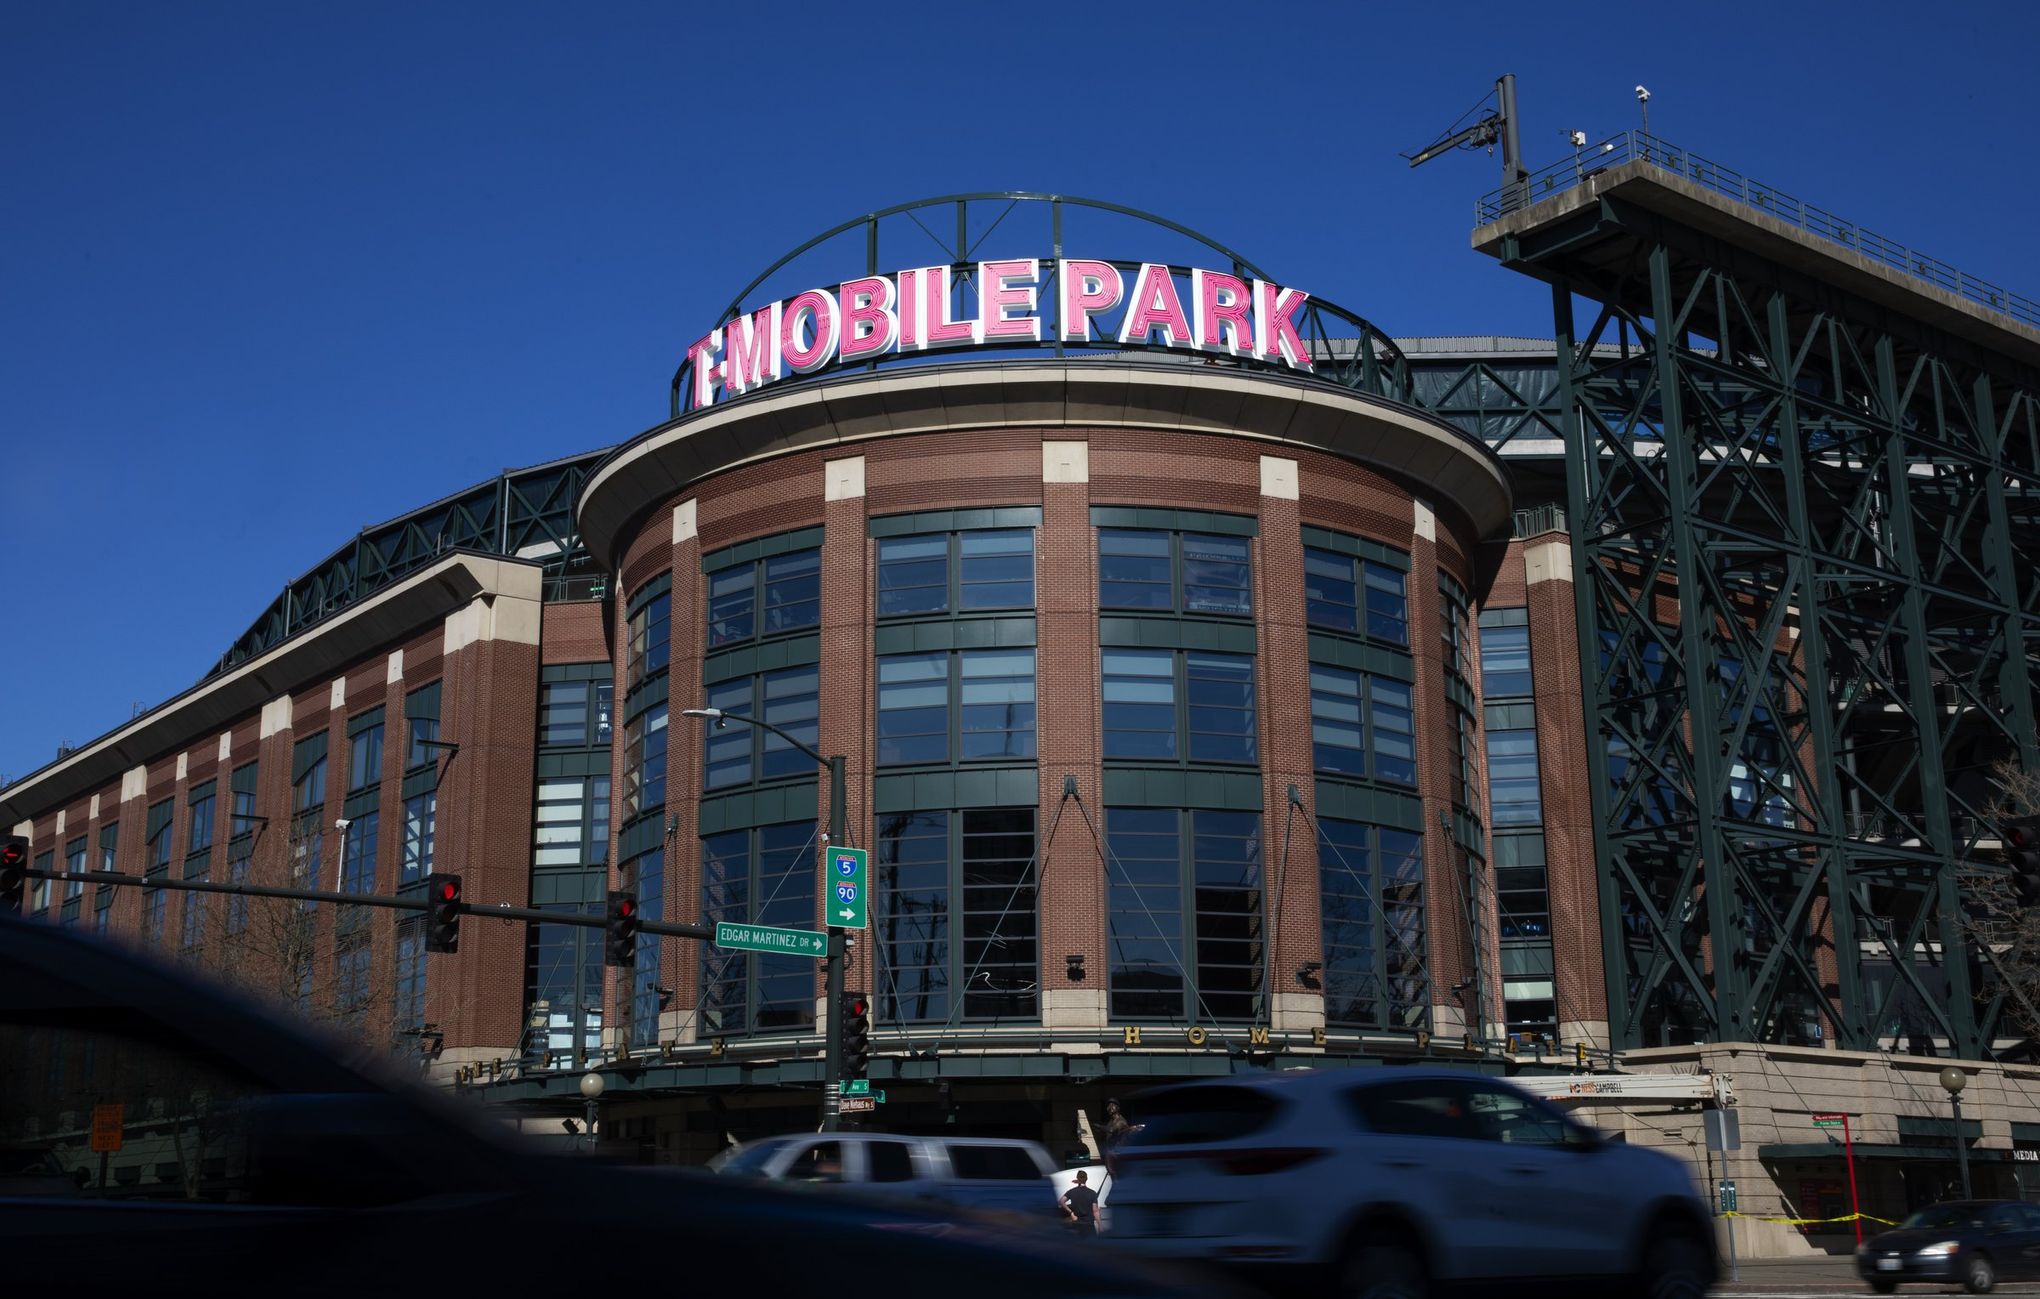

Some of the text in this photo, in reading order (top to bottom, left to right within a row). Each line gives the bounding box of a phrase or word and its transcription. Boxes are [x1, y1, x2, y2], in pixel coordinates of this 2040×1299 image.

[688, 257, 1314, 407] T-MOBILE PARK
[842, 861, 851, 874] 5
[838, 887, 854, 900] 90
[721, 928, 810, 947] EDGAR MARTINEZ DR
[1124, 1025, 1327, 1045] HOME
[864, 1082, 868, 1090] S
[2013, 1150, 2039, 1161] MEDIA
